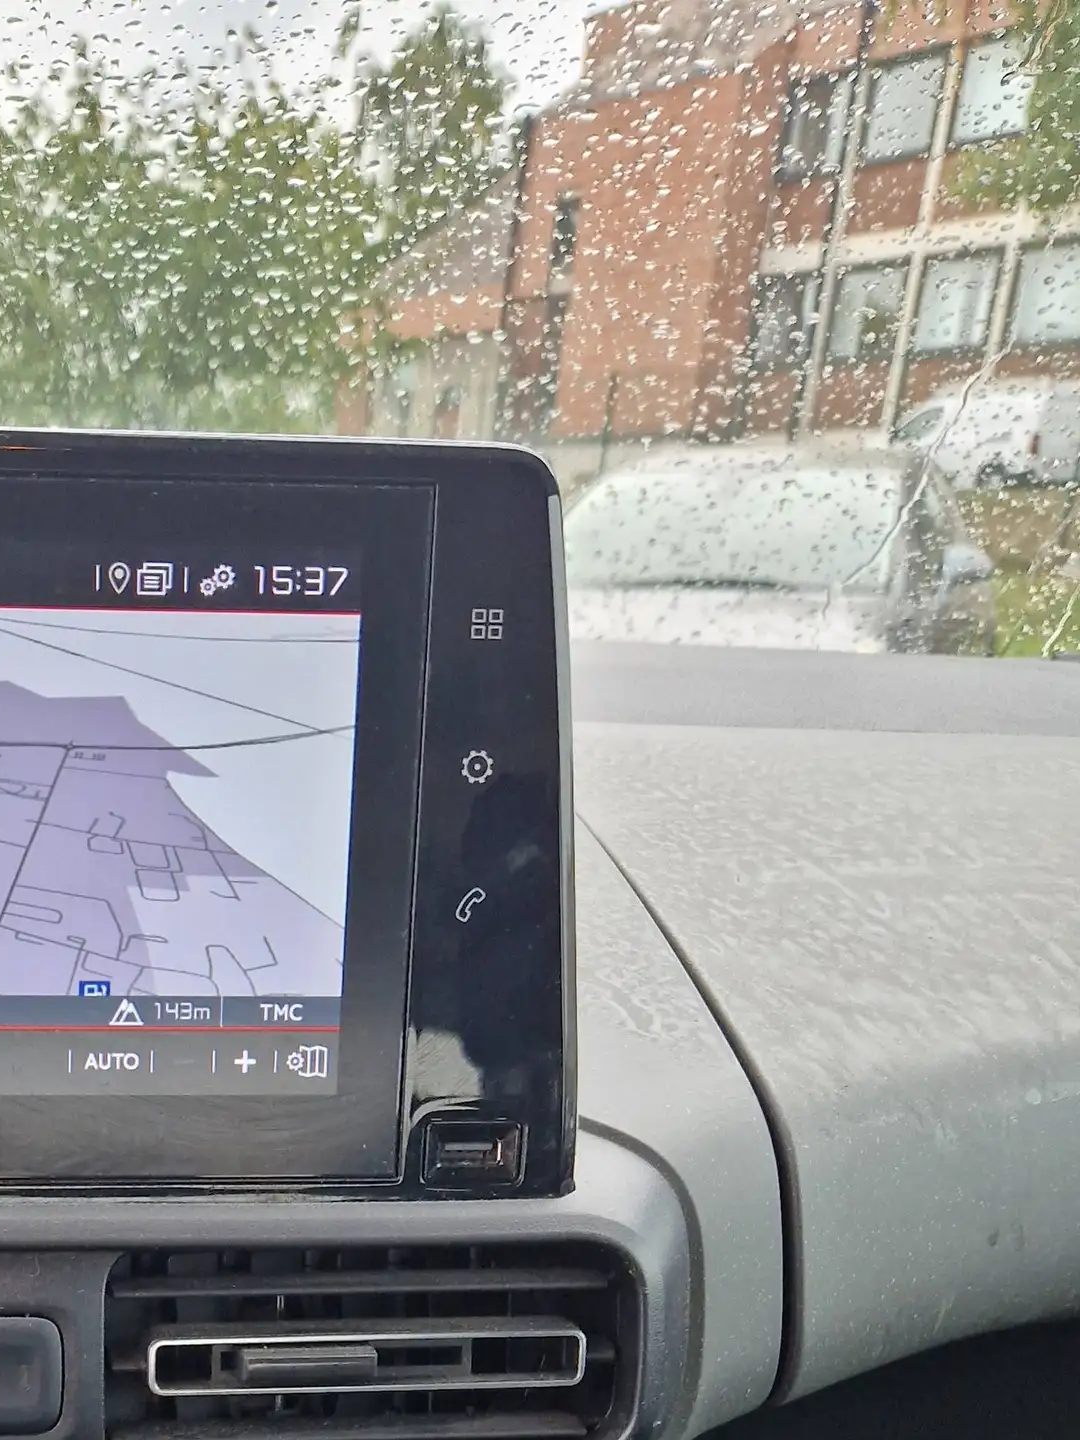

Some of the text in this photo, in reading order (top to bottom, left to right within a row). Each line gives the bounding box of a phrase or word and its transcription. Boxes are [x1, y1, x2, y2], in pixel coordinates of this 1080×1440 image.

[253, 565, 350, 597] 15:37
[154, 1002, 211, 1021] 143m
[260, 1003, 304, 1022] TMC
[84, 1052, 140, 1071] AUTO
